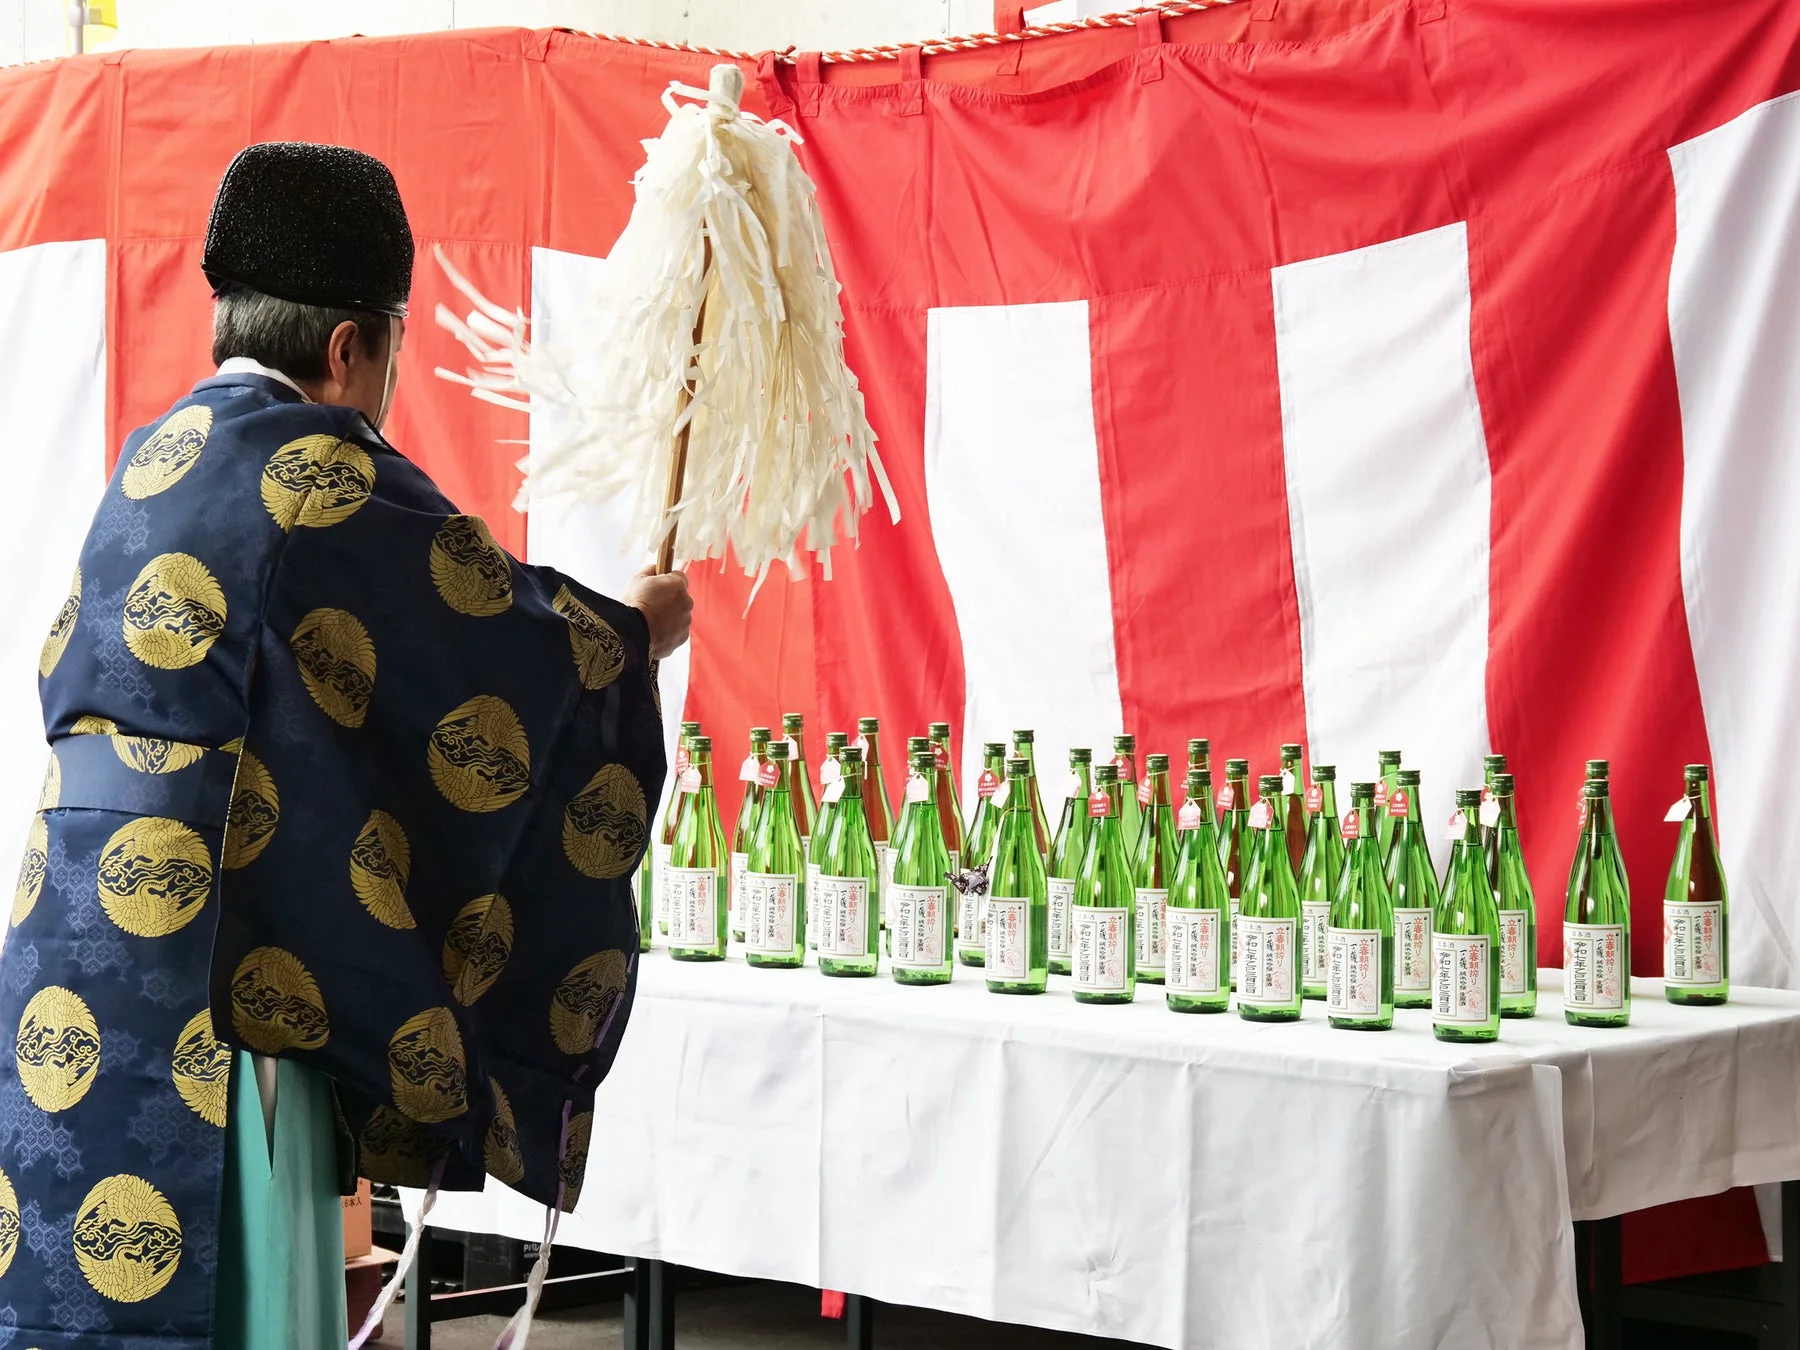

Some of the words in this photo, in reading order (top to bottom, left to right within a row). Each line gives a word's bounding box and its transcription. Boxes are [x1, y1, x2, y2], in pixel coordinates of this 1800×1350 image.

[1469, 944, 1479, 985] 立春朝搾り
[1606, 933, 1615, 973] 立春朝搾り
